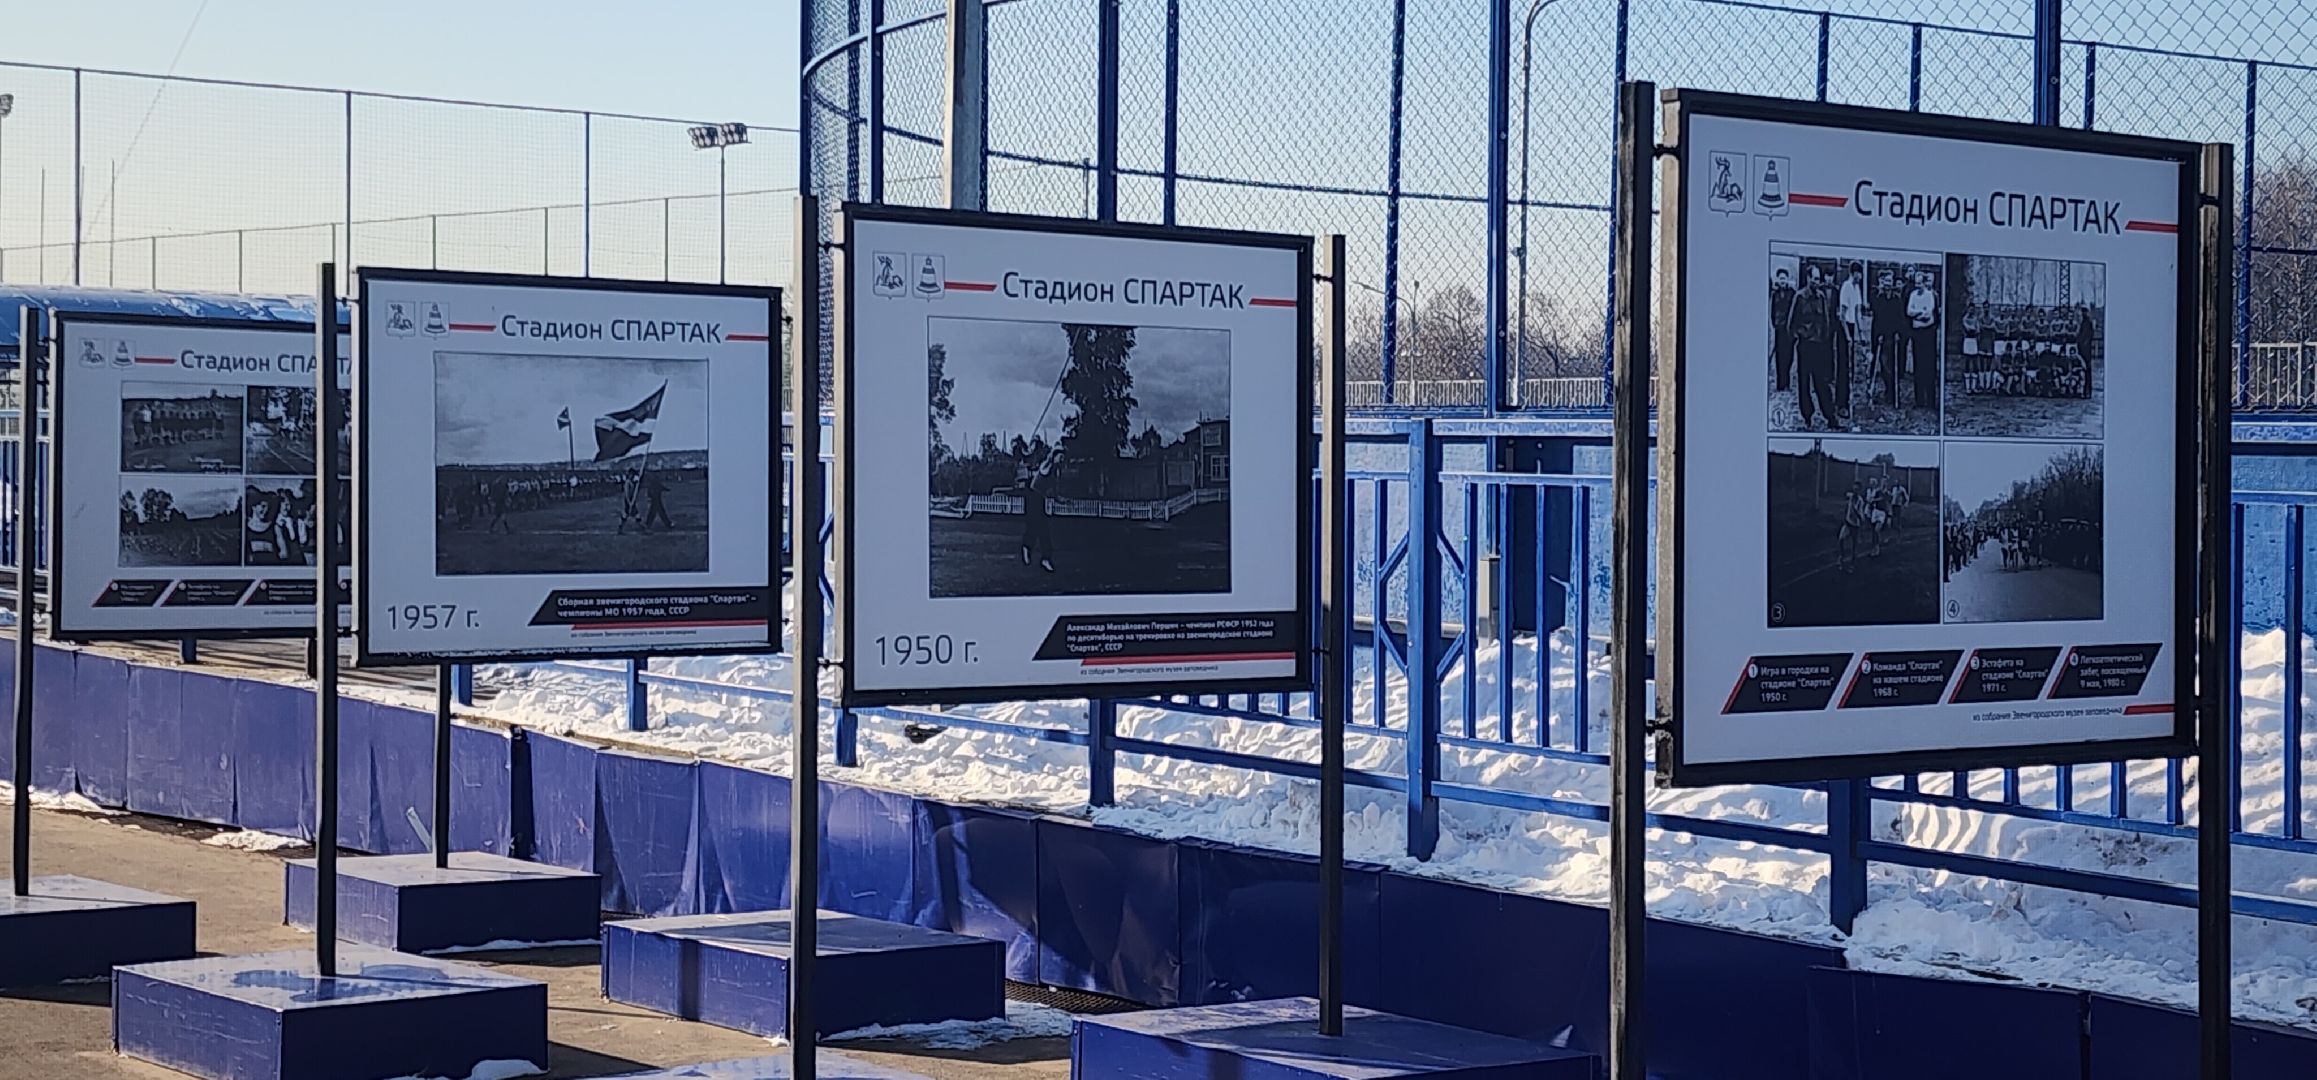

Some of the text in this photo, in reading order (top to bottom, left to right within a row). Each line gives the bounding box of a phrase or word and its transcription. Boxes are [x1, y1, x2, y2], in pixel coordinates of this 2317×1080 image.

[1854, 179, 2121, 235] Стадион СПАРТАК
[1002, 271, 1244, 309] Стадион СПАРТАК
[501, 314, 721, 343] Стадион СПАРТАК
[180, 350, 270, 372] Стадион
[557, 597, 594, 608] Сборная
[595, 596, 669, 606] звенигородского
[669, 595, 709, 605] стадиона
[387, 604, 480, 630] 1957 г.
[557, 606, 690, 618] чемпионы МО 1957 года, СССР
[1066, 623, 1106, 632] Александр
[1106, 622, 1150, 631] Михайлович
[1216, 620, 1240, 628] РСФСР
[875, 634, 979, 665] 1950 г.
[1104, 642, 1123, 651] СССР
[1873, 662, 1907, 672] Команда
[1981, 658, 2014, 669] Эстафета
[1760, 667, 1780, 677] Игра
[1787, 666, 1819, 677] городки
[1820, 666, 1830, 674] на
[1760, 680, 1797, 690] стадионе
[1981, 682, 2000, 693] 1971
[1761, 692, 1781, 702] 1950
